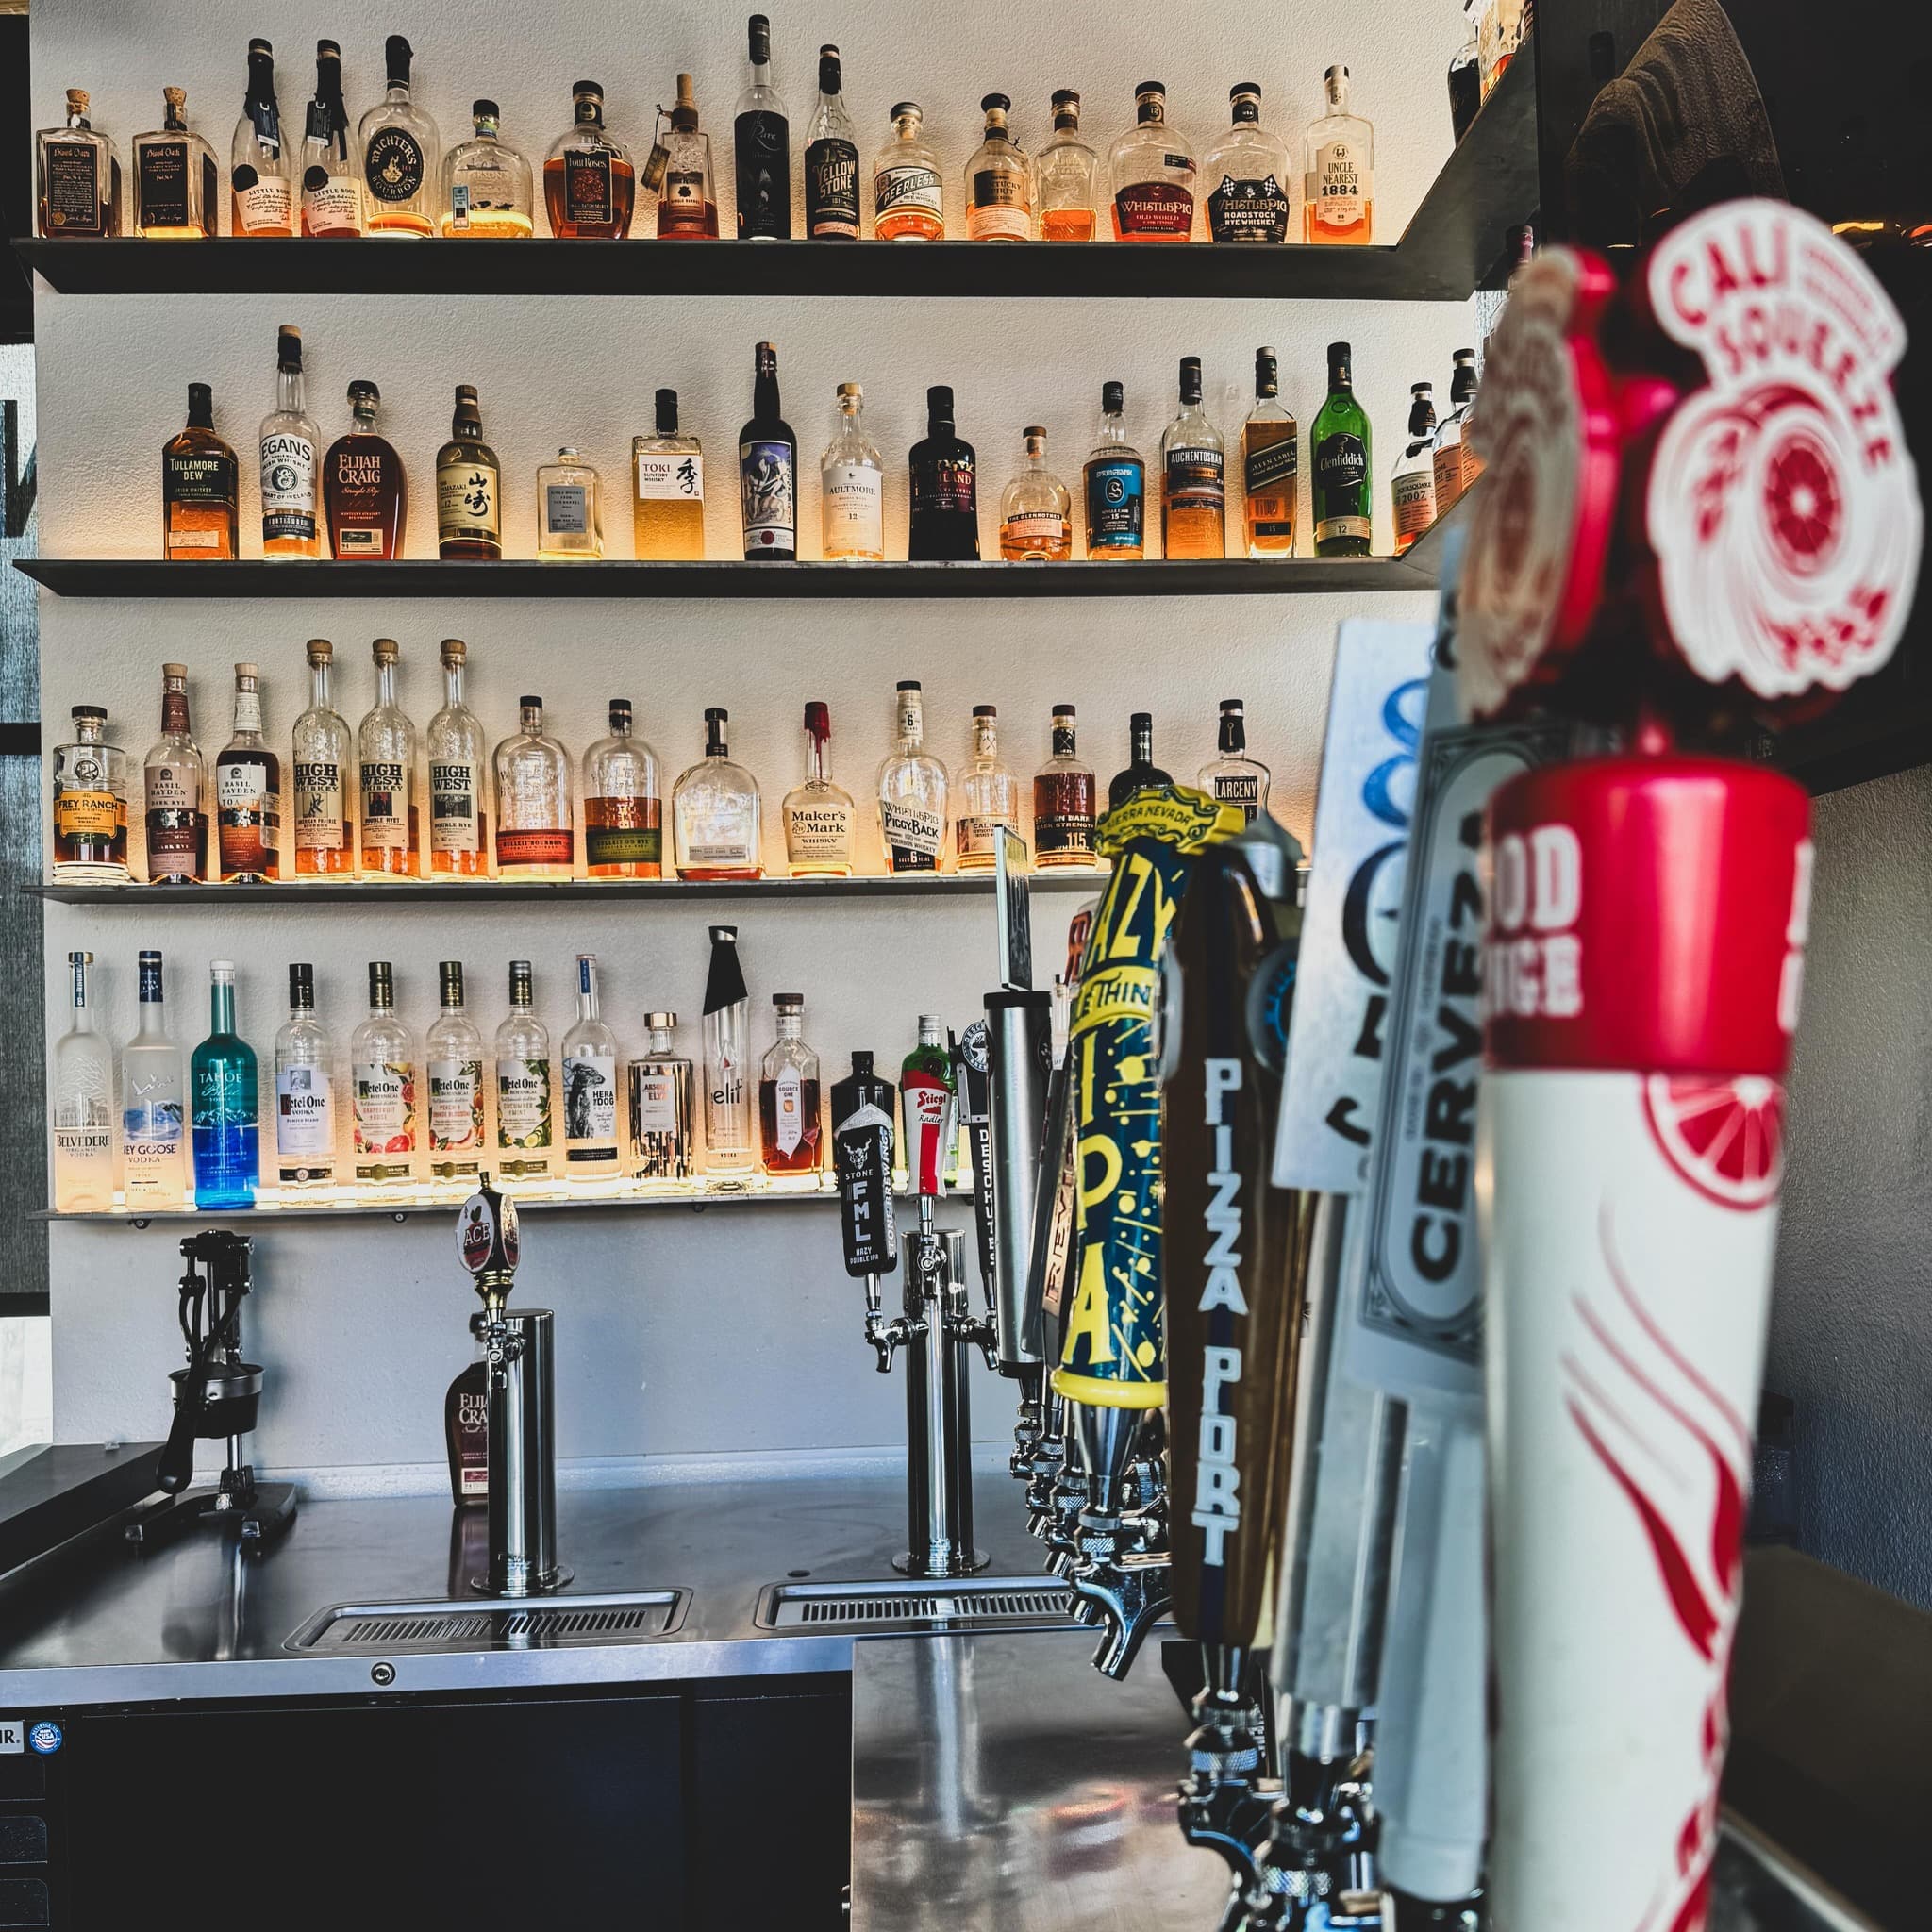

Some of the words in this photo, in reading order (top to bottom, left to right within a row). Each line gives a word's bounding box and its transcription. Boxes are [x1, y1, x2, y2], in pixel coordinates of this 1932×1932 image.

[372, 135, 417, 165] MICHTER'S
[585, 158, 607, 168] Roses
[1328, 162, 1354, 174] UNCLE
[813, 160, 856, 185] YELLOW
[372, 175, 417, 195] BOURBON
[1323, 174, 1358, 185] NEAREST
[314, 189, 339, 197] LITTLE
[820, 175, 853, 198] STONE
[884, 173, 935, 205] PEERLESS
[1322, 185, 1358, 196] 1884
[1669, 220, 1790, 328] CALI
[1716, 304, 1892, 470] SQUEEZE
[261, 438, 311, 462] EGANS
[338, 454, 381, 470] ELIJAH
[1172, 451, 1223, 464] AUCHENTOSHAN
[1321, 453, 1364, 470] Glenfiddich
[170, 458, 219, 471] TULLAMORE
[277, 458, 311, 471] WHISKEY
[642, 463, 672, 472] TOKI
[183, 470, 204, 480] DEW
[338, 469, 381, 484] CRAIG
[676, 458, 698, 494] 季
[465, 472, 491, 517] 山崎
[829, 486, 875, 496] AULTMORE
[1402, 491, 1426, 503] 2007
[908, 715, 913, 726] 6
[294, 764, 338, 775] HIGH
[362, 764, 402, 775] HIGH
[433, 765, 471, 777] HIGH
[296, 776, 338, 787] WEST
[362, 776, 403, 787] WEST
[434, 778, 472, 791] WEST
[1215, 781, 1257, 798] LARCENY
[58, 800, 79, 809] FREY
[82, 800, 118, 809] RANCH
[792, 811, 845, 821] Maker's
[1146, 805, 1190, 826] NEVADA
[807, 823, 845, 832] Mark
[885, 812, 938, 838] PIGGYBACK
[891, 838, 913, 847] BOURBON
[914, 842, 936, 853] WHISKEY
[1066, 832, 1087, 847] 115
[911, 851, 917, 864] 6
[1085, 852, 1179, 972] AZY
[1096, 973, 1153, 1008] THIN
[1410, 813, 1485, 1287] CERVEZ
[199, 1073, 242, 1083] TAHOE
[523, 1079, 538, 1089] One
[383, 1083, 398, 1092] One
[712, 1079, 742, 1104] elit
[307, 1096, 325, 1108] One
[917, 1091, 946, 1109] Stiegl
[918, 1115, 945, 1124] Radler
[57, 1135, 109, 1147] BELVEDERE
[138, 1144, 175, 1155] GOOSE
[845, 1169, 874, 1180] STONE
[881, 1135, 893, 1205] BREWING
[1199, 1058, 1248, 1315] PIZZA
[979, 1129, 996, 1266] DESCHUTES
[1063, 1030, 1123, 1370] IPA
[852, 1181, 872, 1241] FML
[464, 1223, 491, 1246] ACE
[855, 1247, 873, 1257] HAZY
[459, 1408, 489, 1424] CRA
[1192, 1345, 1242, 1567] PORT
